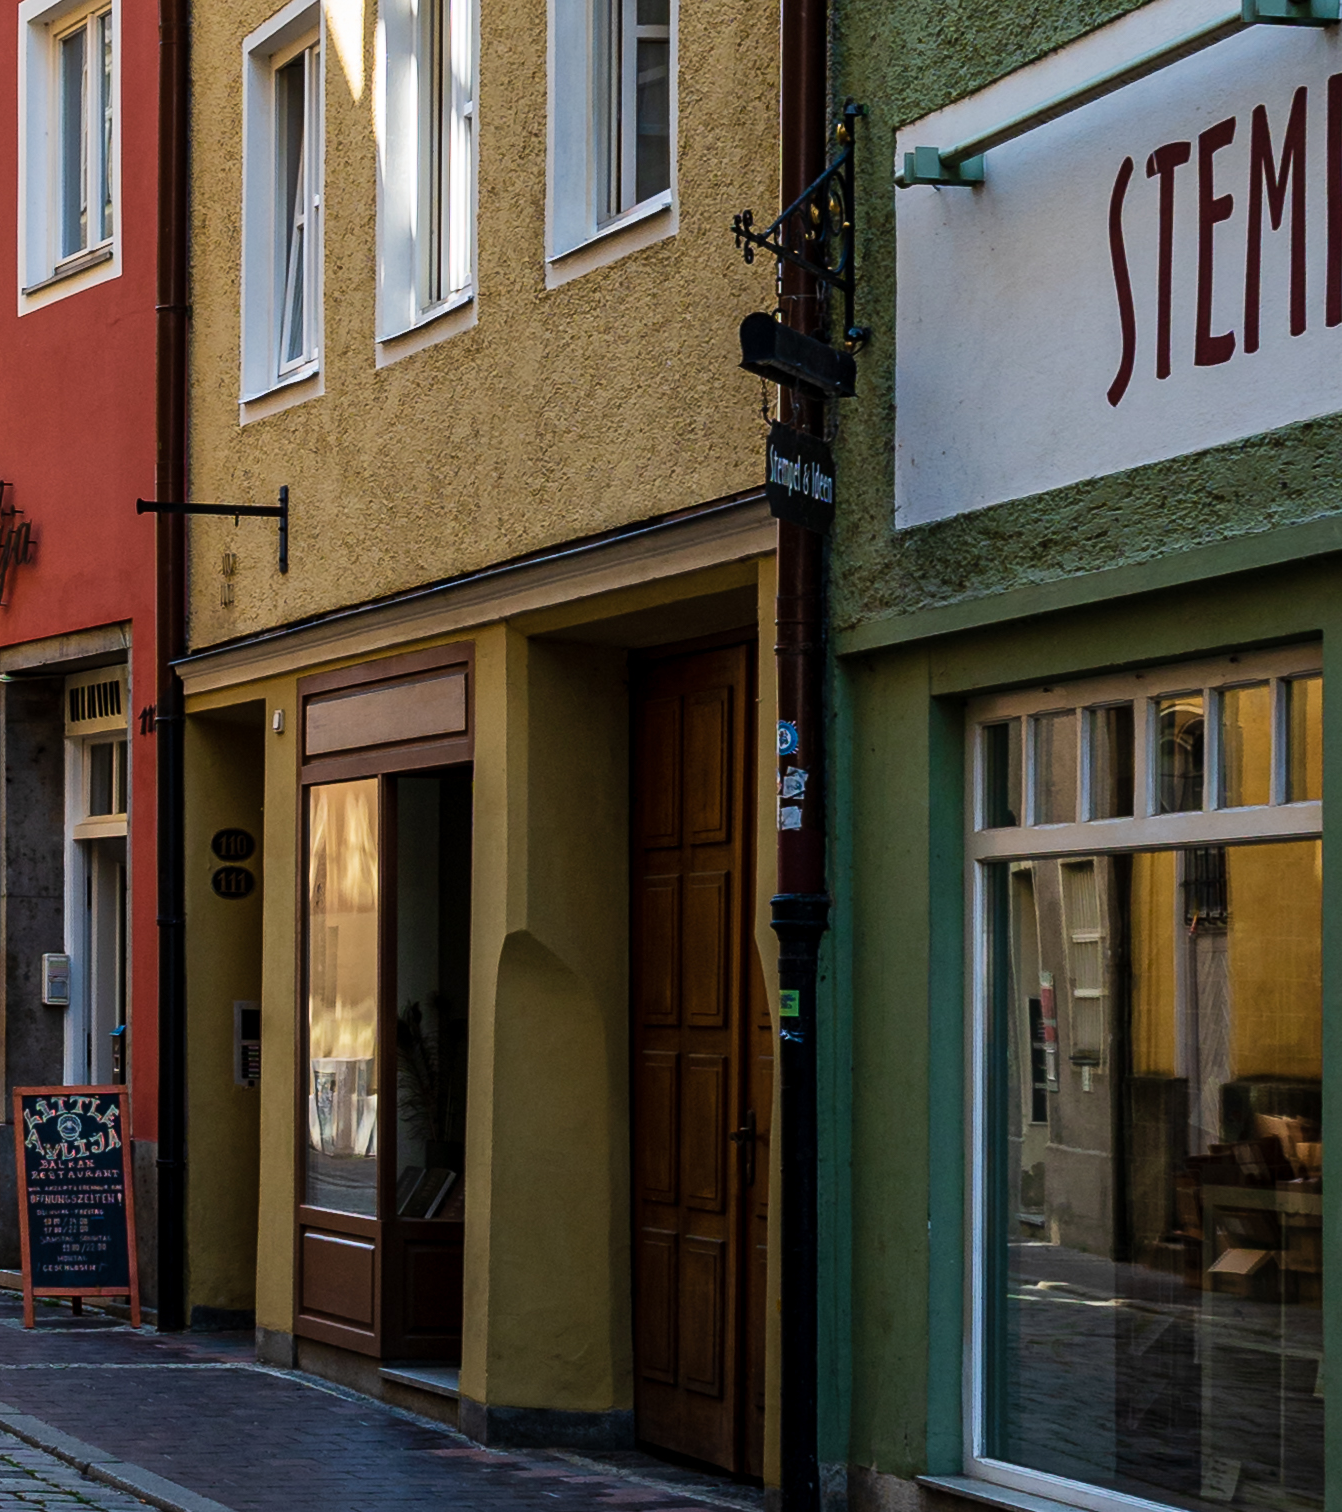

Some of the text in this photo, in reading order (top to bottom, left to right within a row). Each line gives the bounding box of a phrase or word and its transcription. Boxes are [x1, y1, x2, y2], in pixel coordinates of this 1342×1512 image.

[769, 443, 833, 504] Stempel & Ideen
[218, 834, 247, 856] 110
[217, 871, 247, 893] 111
[23, 1095, 119, 1130] LITTLE
[25, 1128, 122, 1160] AVLIJA
[31, 1169, 120, 1180] RESTAURANT
[39, 1159, 95, 1169] BALKAN
